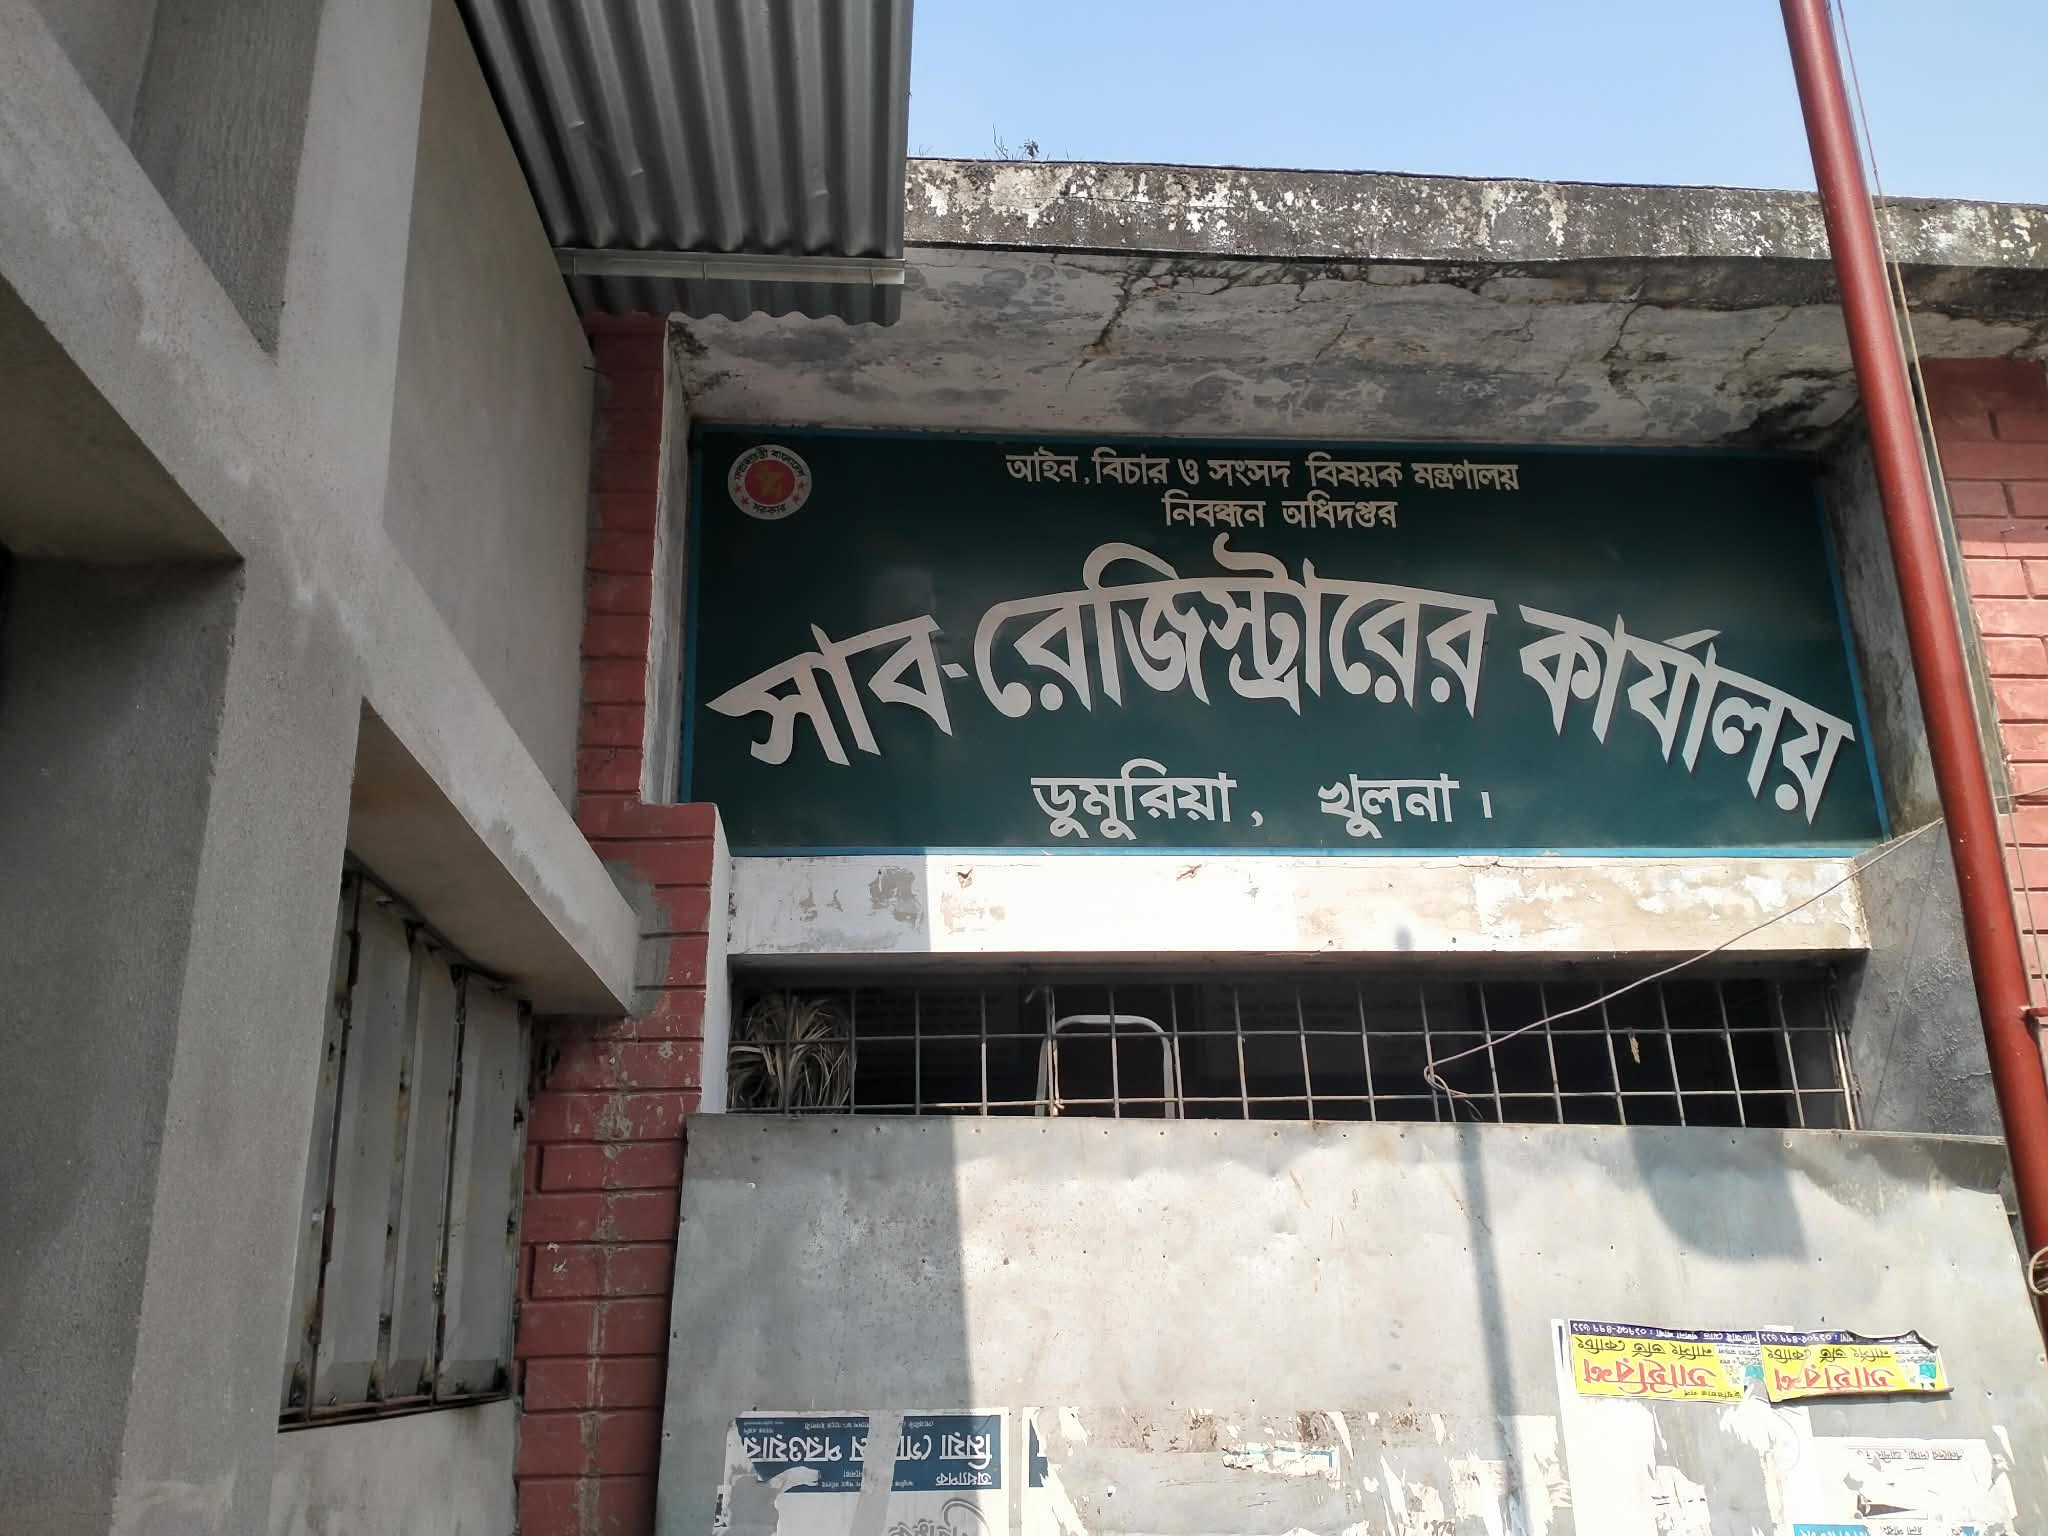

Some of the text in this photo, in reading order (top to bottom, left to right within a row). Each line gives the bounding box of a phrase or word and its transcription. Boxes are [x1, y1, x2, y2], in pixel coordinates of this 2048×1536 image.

[1092, 447, 1169, 484] বিচার
[1178, 459, 1200, 484] ও
[1208, 460, 1291, 487] সংসদ
[1305, 452, 1402, 487] বিষয়ক
[1411, 459, 1519, 490] মন্ত্রণালয়
[1162, 489, 1399, 529] নিবন্ধন অধিদপ্তর
[1519, 604, 1856, 826] কার্যালয়
[1577, 1337, 1626, 1355] কোচিং
[1632, 1342, 1666, 1358] ভর্তি
[1671, 1342, 1713, 1360] নার্সিং
[1818, 1347, 1847, 1363] ভর্তি
[1849, 1347, 1891, 1363] নার্সিং
[1764, 1347, 1811, 1364] কোচিং
[1584, 1357, 1717, 1395] আইরিশ
[742, 1434, 842, 1463] পরওয়ার
[939, 1432, 992, 1470] মিয়া
[935, 1472, 992, 1486] অধ্যাপক
